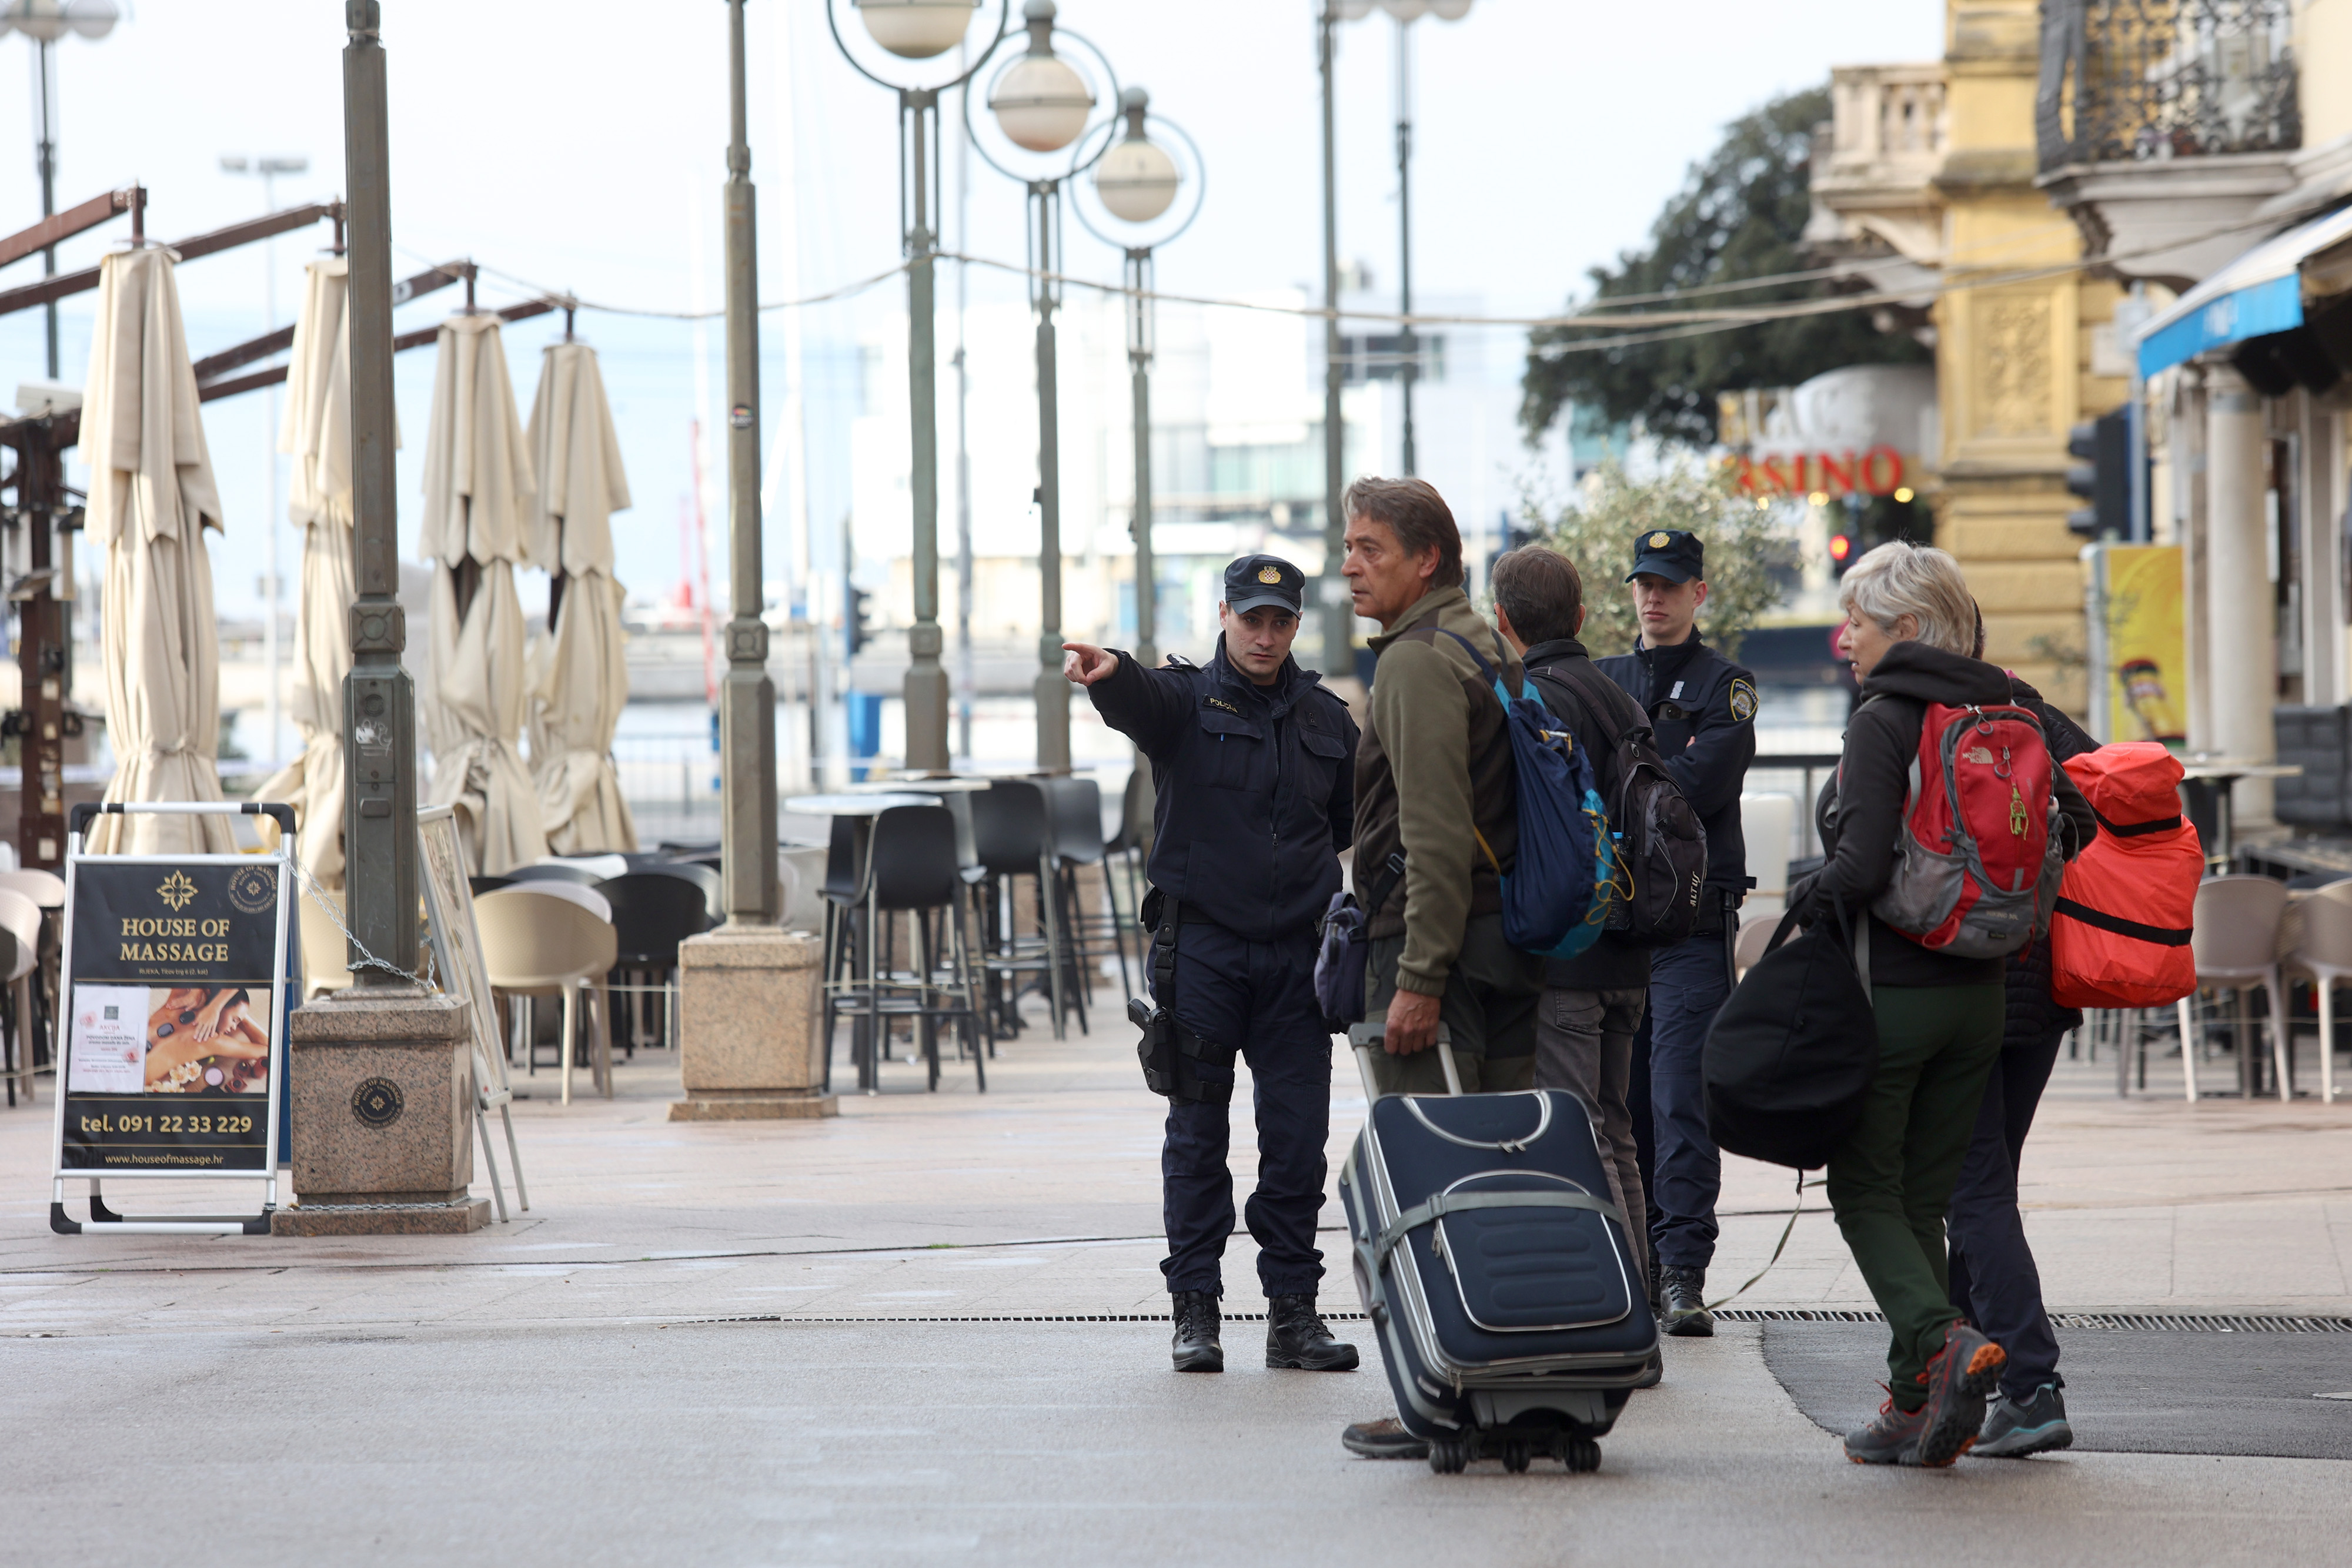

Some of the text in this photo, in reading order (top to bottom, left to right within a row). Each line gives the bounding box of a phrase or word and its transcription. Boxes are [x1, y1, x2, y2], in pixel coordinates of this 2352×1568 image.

[1690, 871, 1701, 907] ALTUS
[121, 918, 230, 938] HOUSE OF
[119, 942, 228, 962] MASSAGE
[81, 1114, 253, 1134] tel. 091 22 33 229
[105, 1153, 223, 1166] www.houseofmassage.hr
